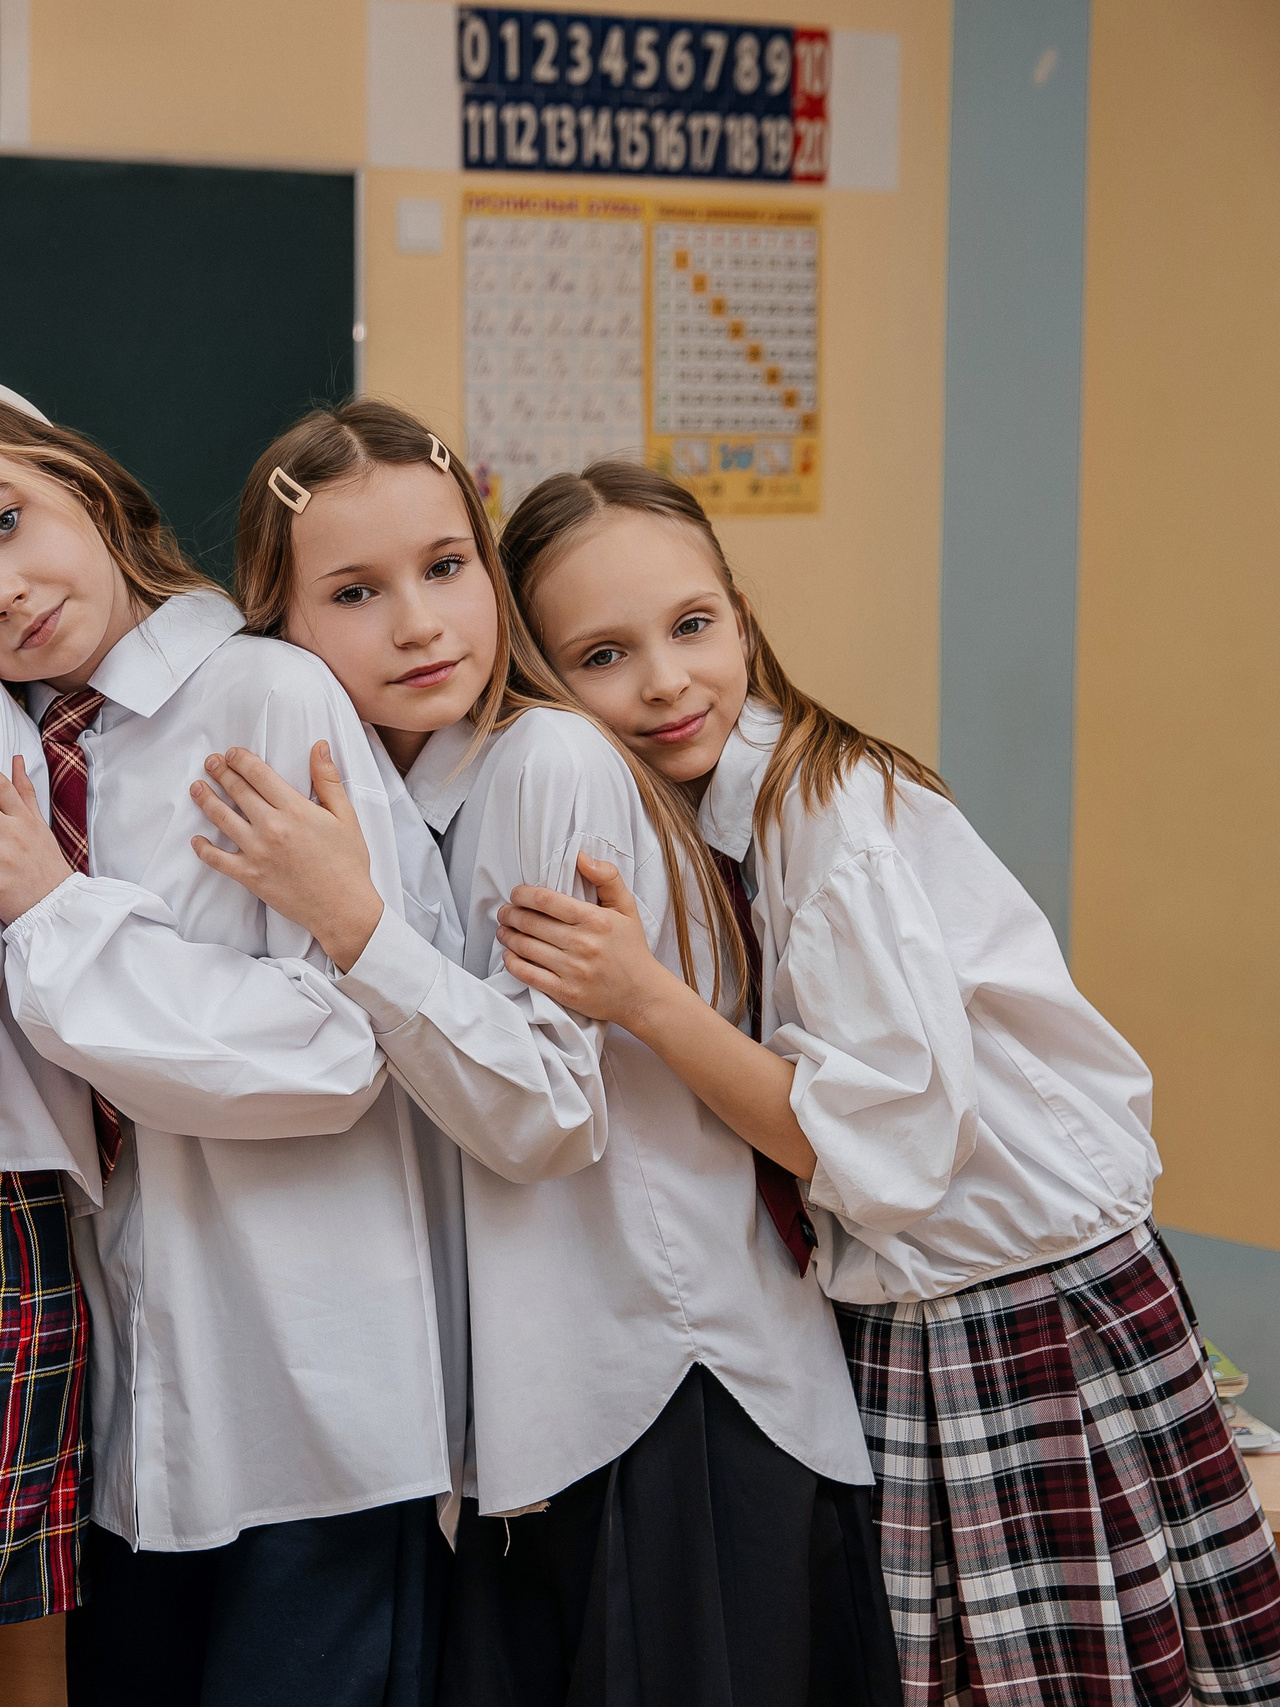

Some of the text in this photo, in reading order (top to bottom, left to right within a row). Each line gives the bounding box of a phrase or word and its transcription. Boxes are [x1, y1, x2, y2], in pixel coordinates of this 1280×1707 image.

[463, 14, 490, 81] 0
[499, 18, 520, 82] 1
[531, 19, 559, 84] 2
[565, 21, 593, 86] 3
[599, 24, 628, 87] 4
[632, 27, 660, 90] 5
[666, 28, 696, 92] 6
[701, 30, 729, 92] 7
[733, 31, 762, 96] 8
[765, 34, 792, 97] 9
[465, 102, 497, 164] 11
[500, 102, 539, 165] 12
[541, 103, 577, 167] 13
[578, 105, 614, 167] 14
[615, 107, 649, 170] 15
[651, 110, 687, 173] 16
[686, 111, 723, 173] 17
[724, 112, 760, 175] 18
[760, 114, 793, 176] 19
